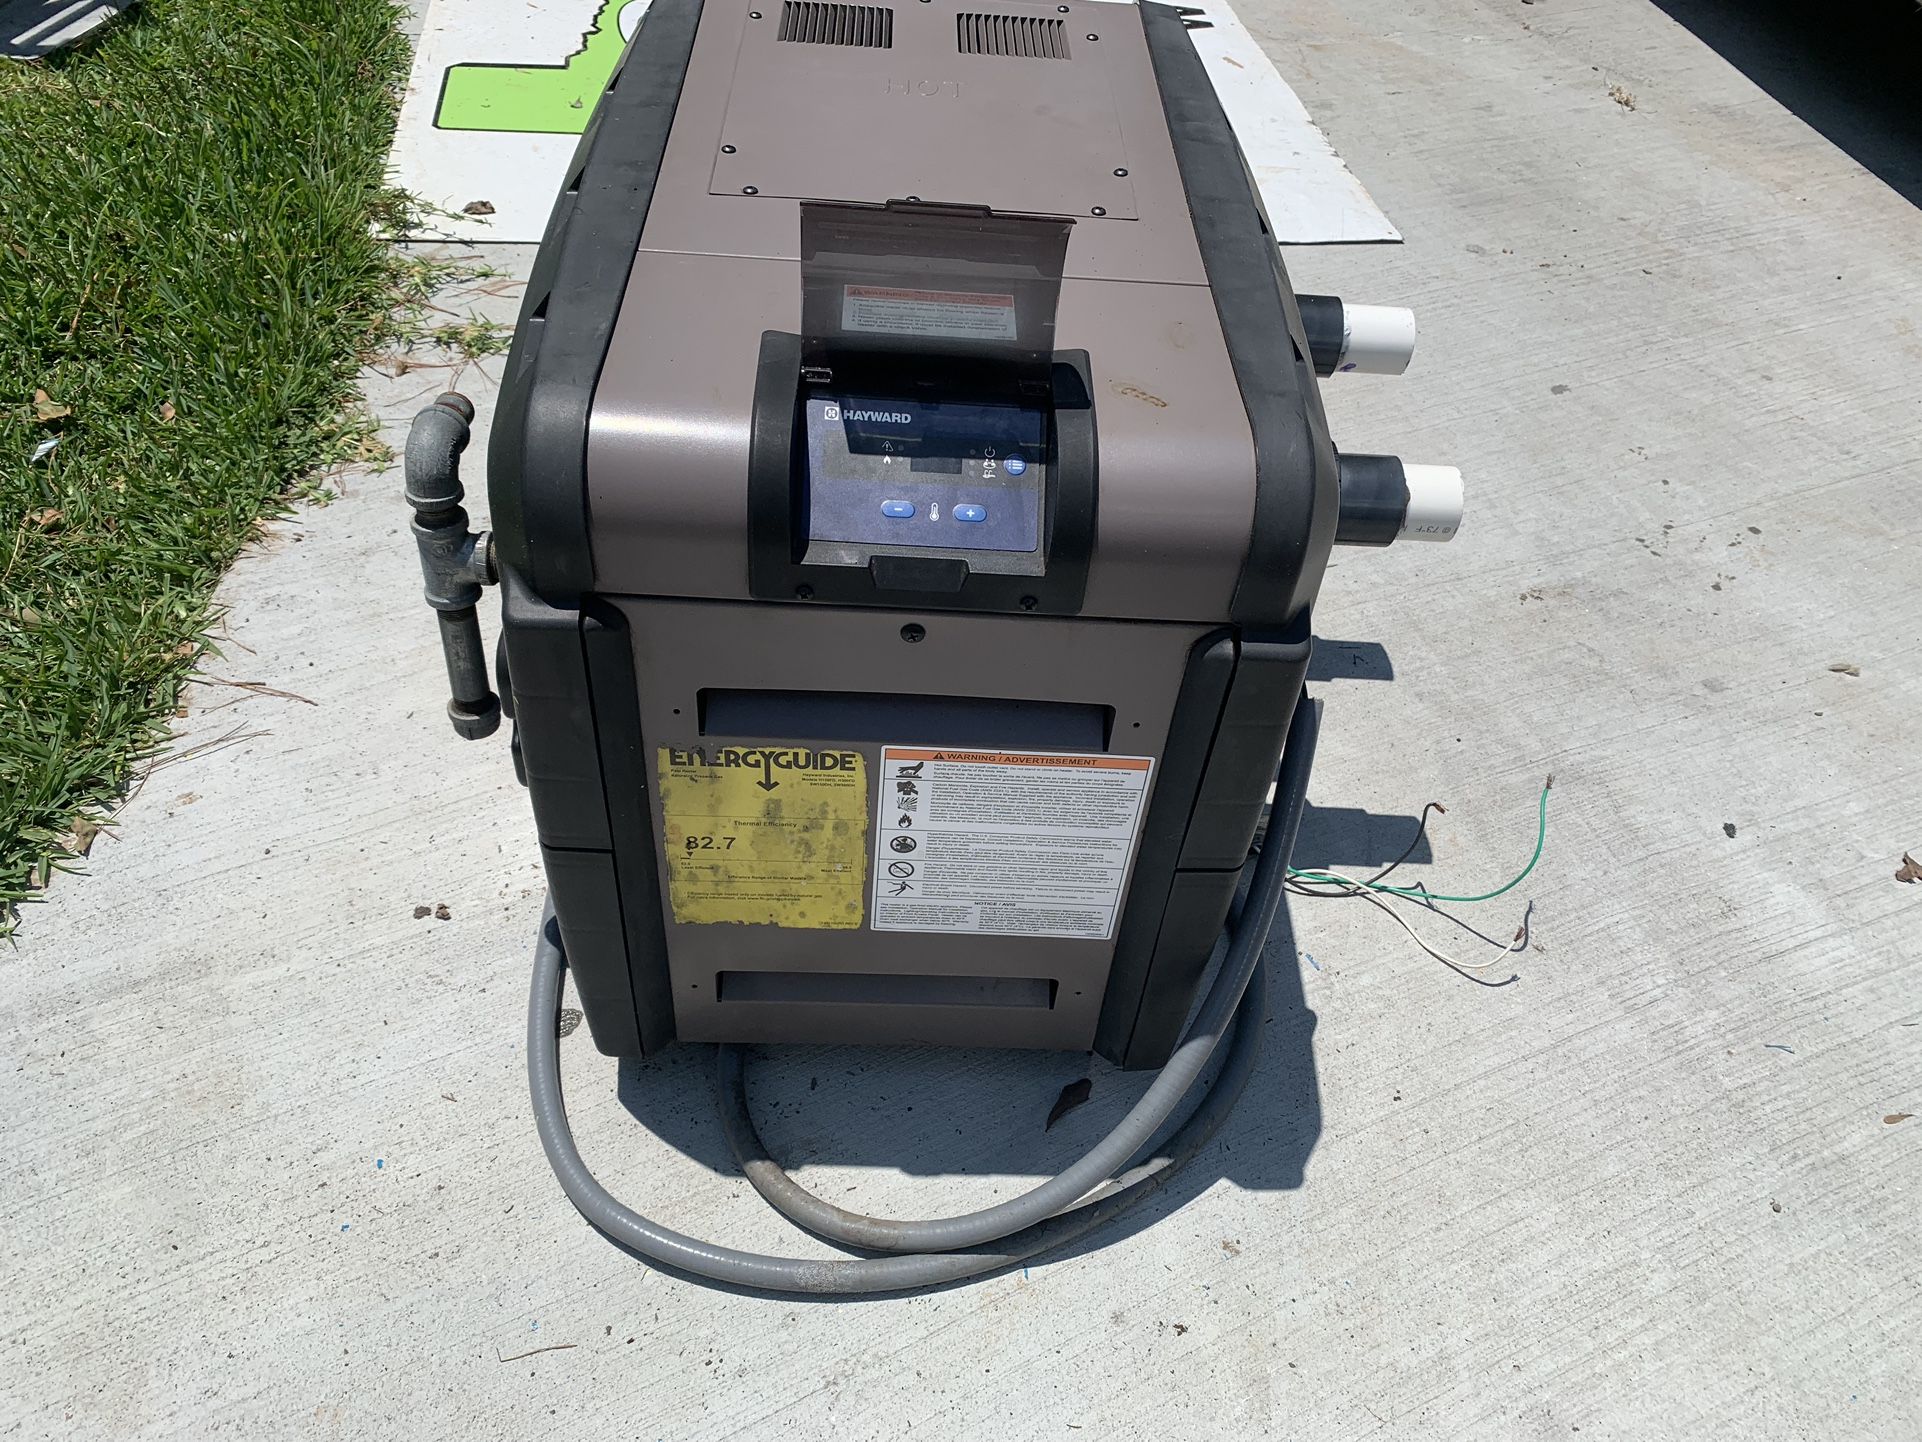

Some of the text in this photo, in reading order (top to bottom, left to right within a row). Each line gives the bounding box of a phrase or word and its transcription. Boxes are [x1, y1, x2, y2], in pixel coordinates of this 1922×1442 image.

[883, 78, 968, 98] HOT
[844, 410, 911, 424] HAYWARD
[948, 753, 996, 762] WARNING
[1004, 757, 1098, 766] ADVERTISSEMENT
[686, 836, 736, 850] 82.7
